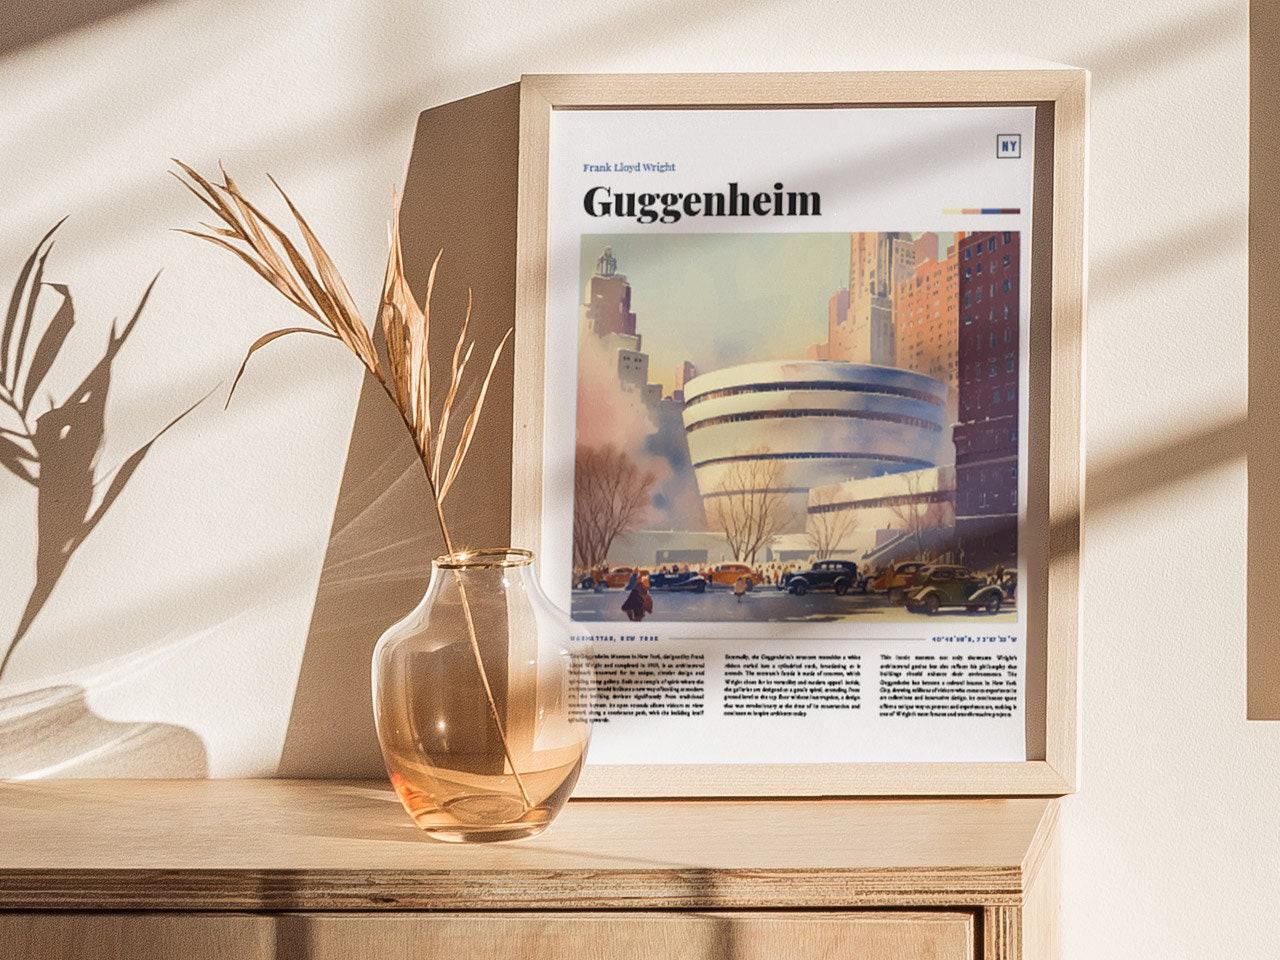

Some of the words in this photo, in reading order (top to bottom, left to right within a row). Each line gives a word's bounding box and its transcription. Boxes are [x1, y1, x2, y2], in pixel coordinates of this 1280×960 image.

[1002, 141, 1016, 151] NY
[583, 163, 611, 172] Frank
[614, 162, 640, 173] Lloyd
[643, 162, 675, 173] Wright
[584, 183, 821, 224] Guggenheim
